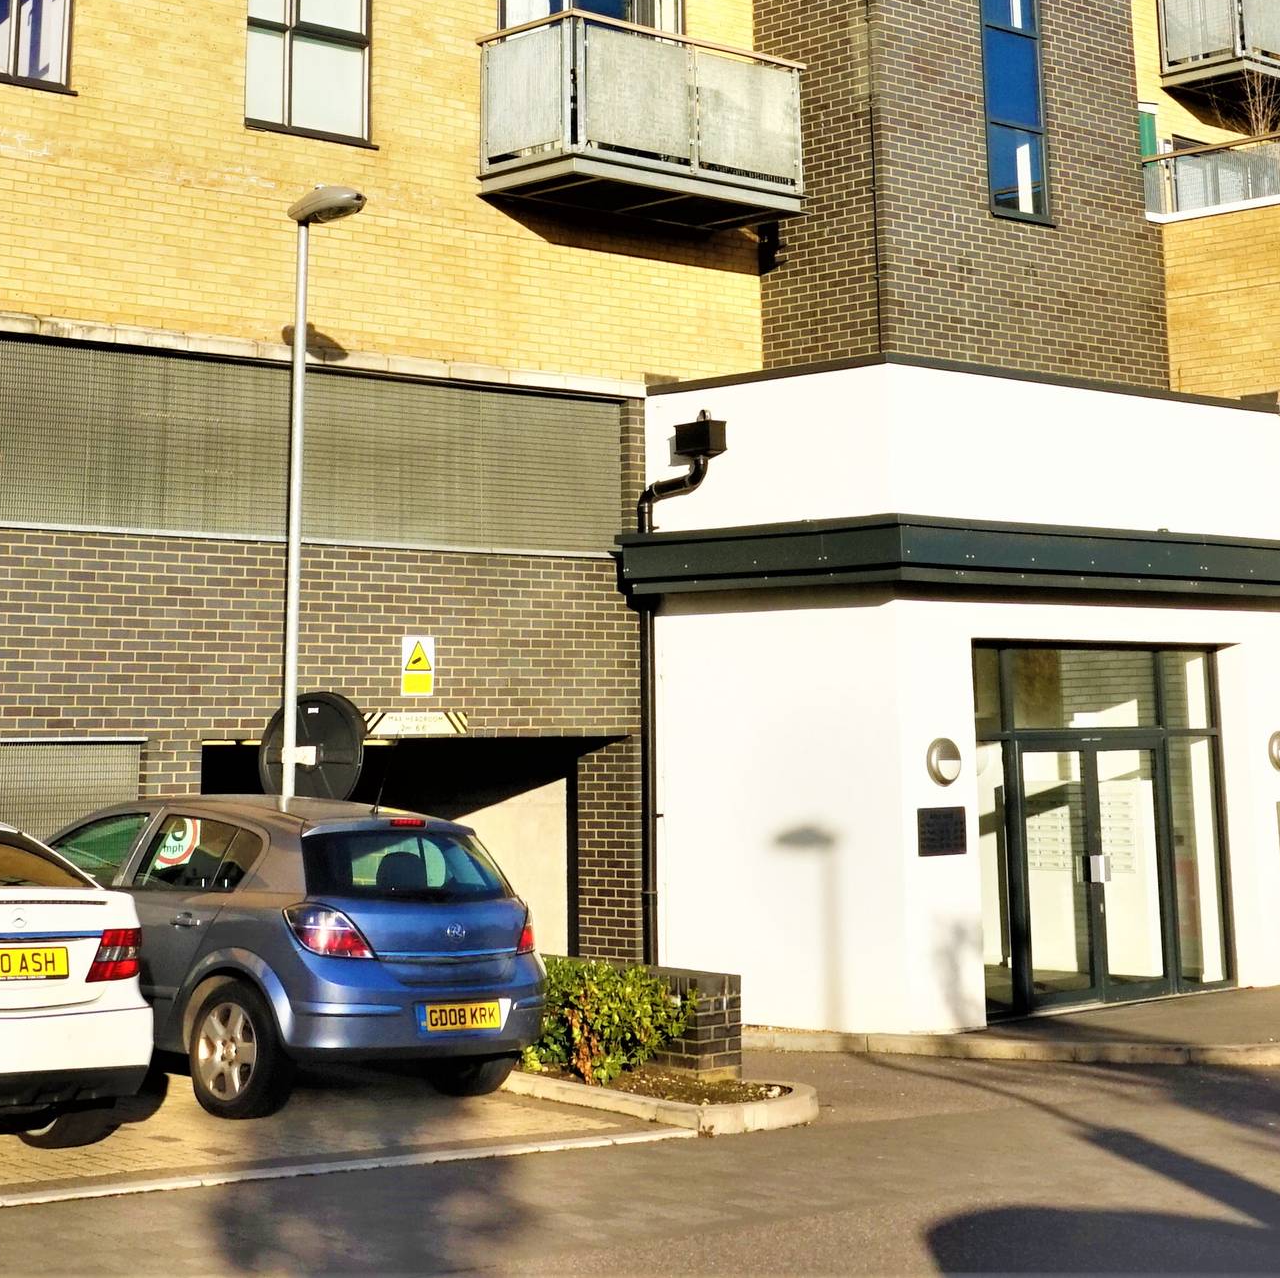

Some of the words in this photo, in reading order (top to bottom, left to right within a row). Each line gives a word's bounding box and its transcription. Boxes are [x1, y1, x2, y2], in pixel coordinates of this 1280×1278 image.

[163, 843, 184, 854] mph
[19, 952, 56, 972] ASH
[429, 1008, 467, 1027] GD08
[470, 1007, 497, 1025] KRK
